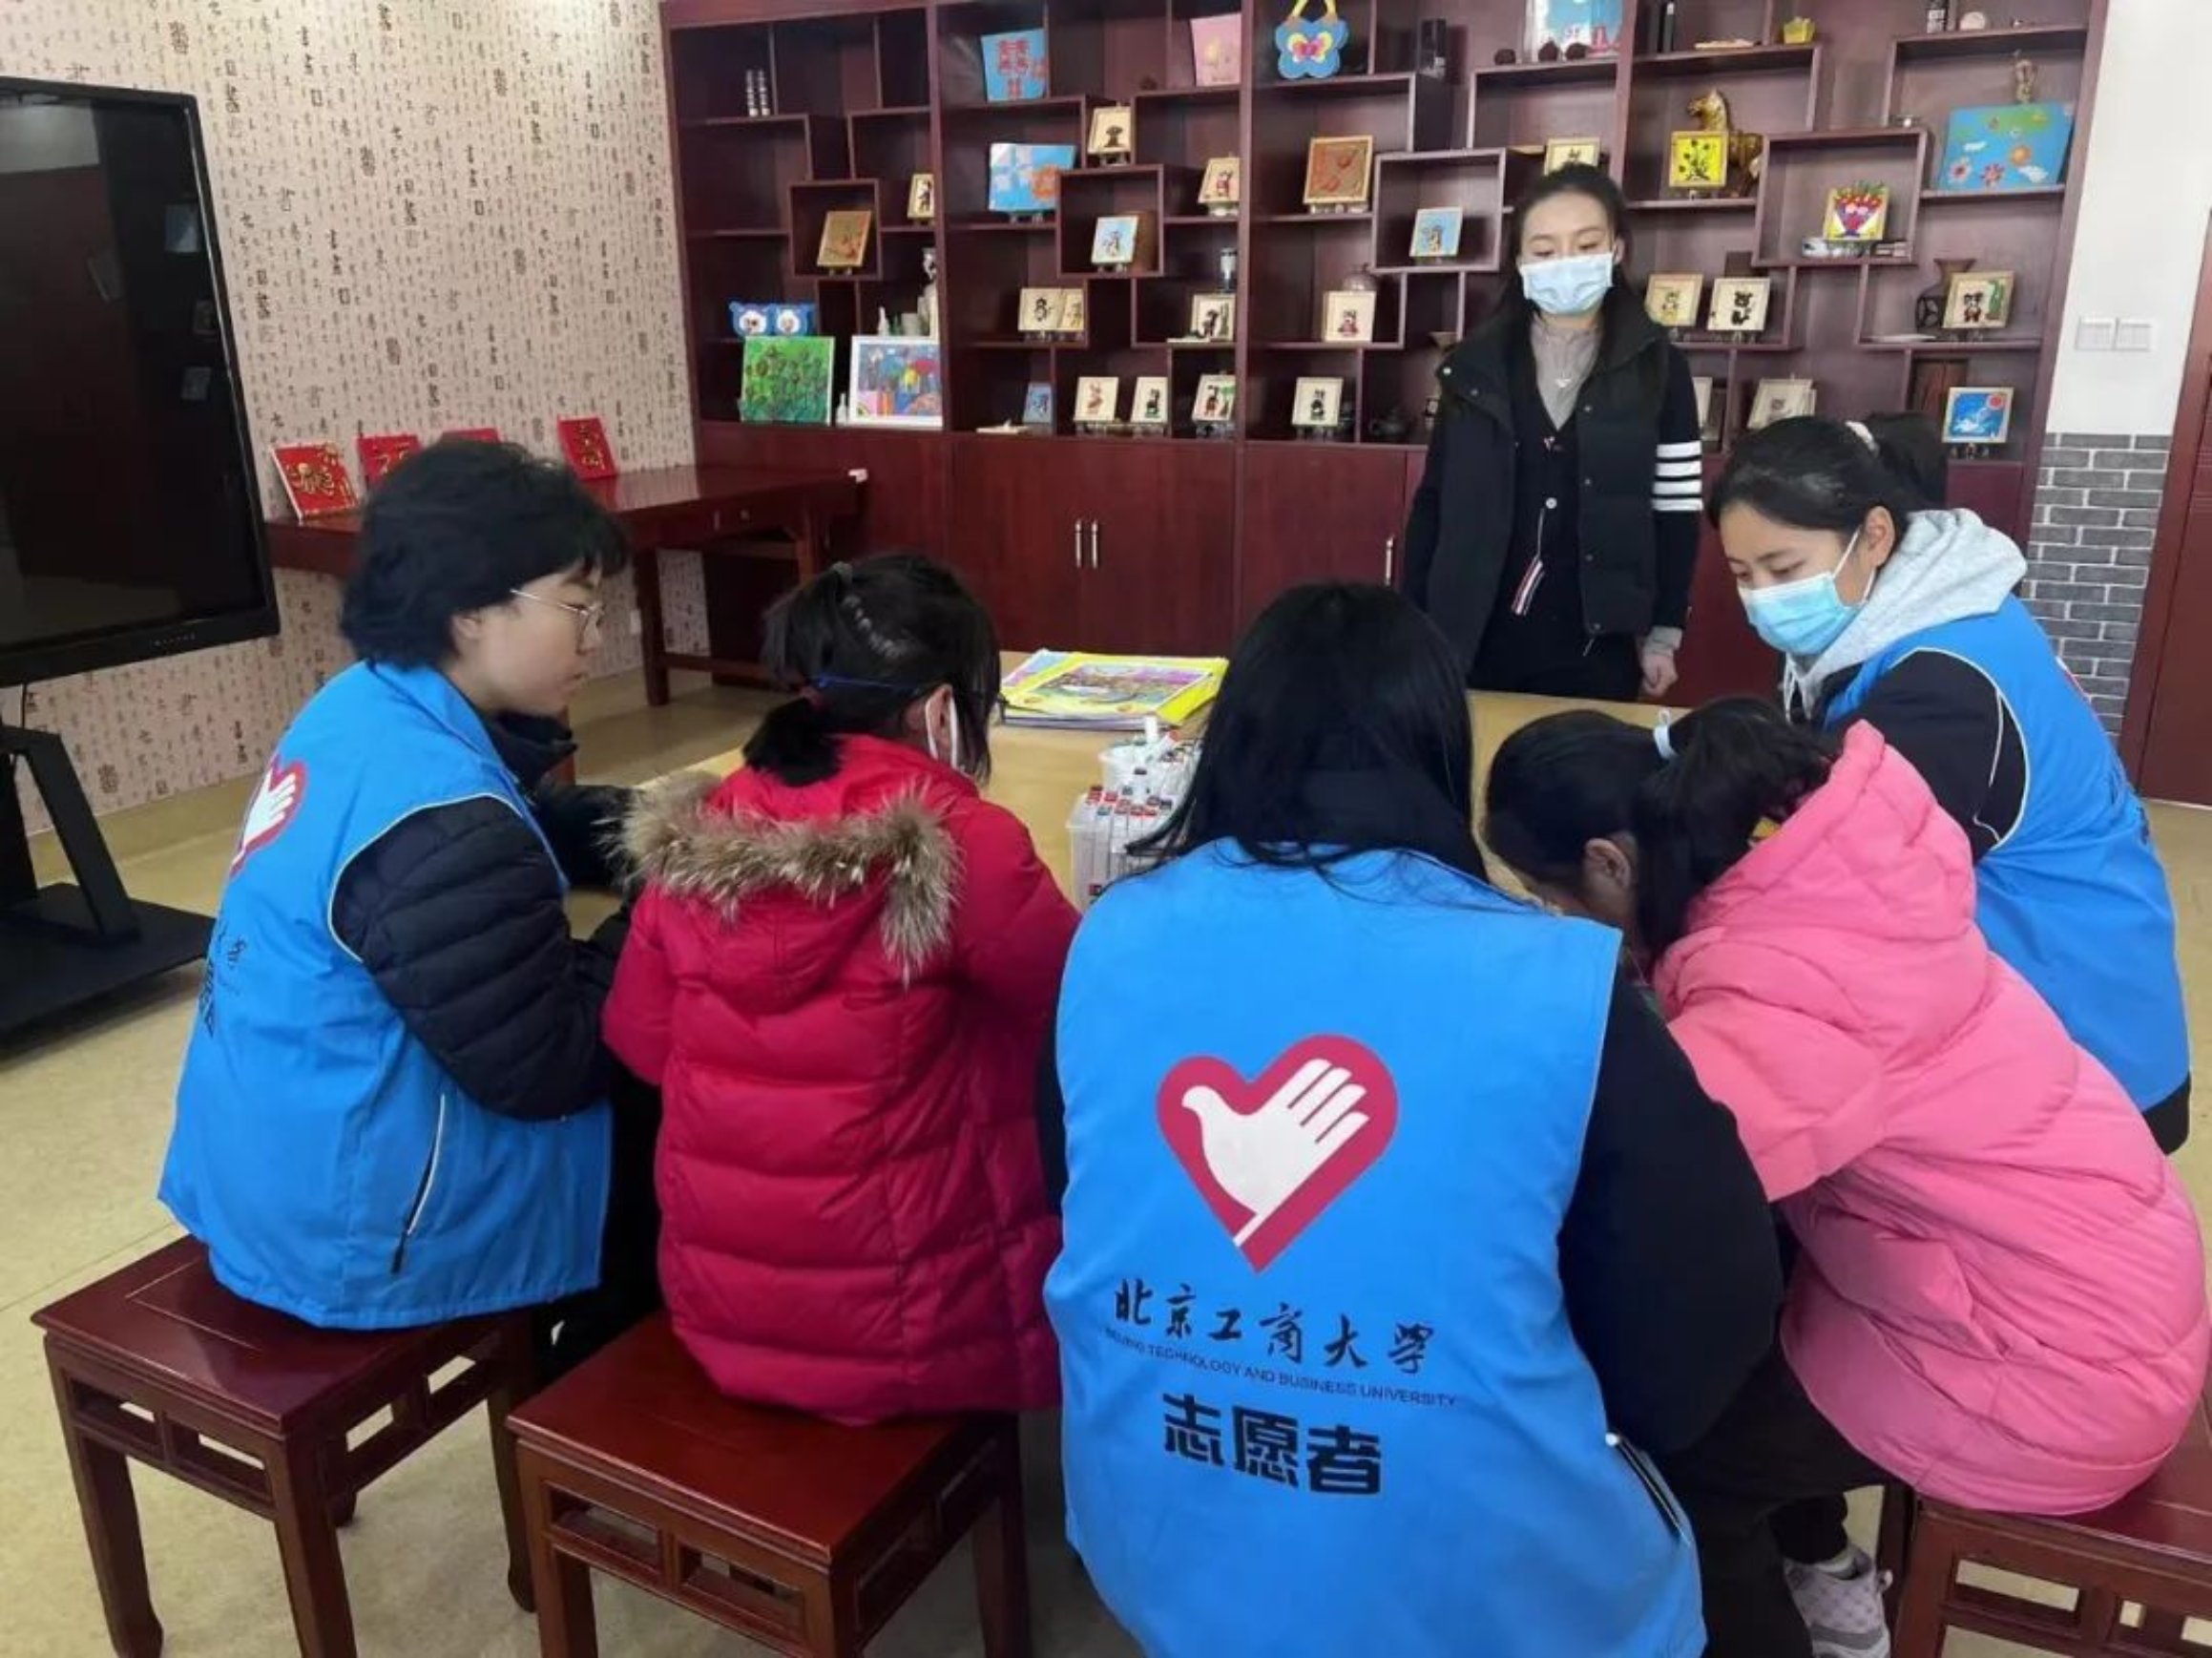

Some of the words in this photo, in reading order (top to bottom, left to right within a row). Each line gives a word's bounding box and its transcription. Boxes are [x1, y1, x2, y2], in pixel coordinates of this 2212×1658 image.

[1148, 1344, 1241, 1376] TECHNOLOGY
[1244, 1366, 1276, 1384] AND
[1279, 1372, 1357, 1396] BUSINESS
[1360, 1382, 1456, 1408] UNIVERSITY
[1163, 1393, 1382, 1495] 志愿者
